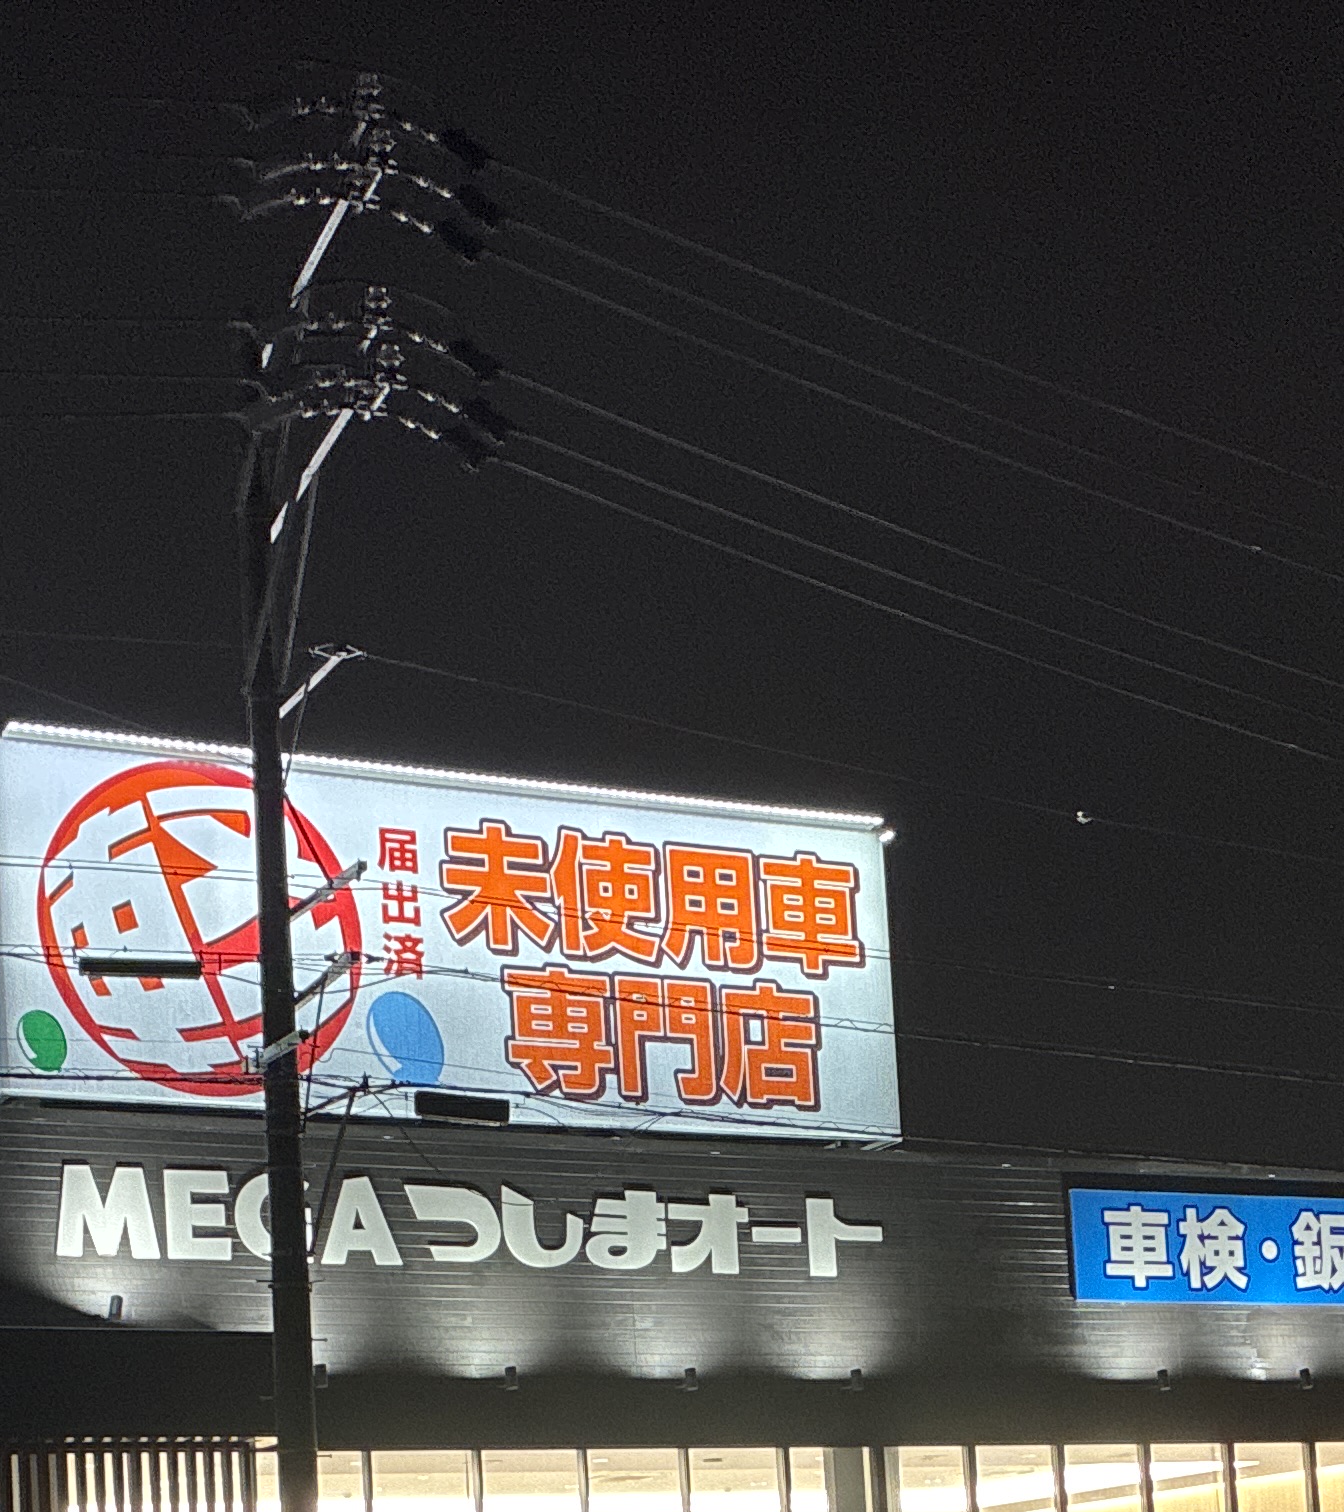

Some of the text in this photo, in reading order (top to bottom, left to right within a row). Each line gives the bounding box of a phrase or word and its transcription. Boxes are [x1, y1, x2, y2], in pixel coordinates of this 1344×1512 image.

[377, 827, 424, 980] 届出済
[441, 820, 863, 975] 未使用車
[503, 966, 819, 1111] 専門店
